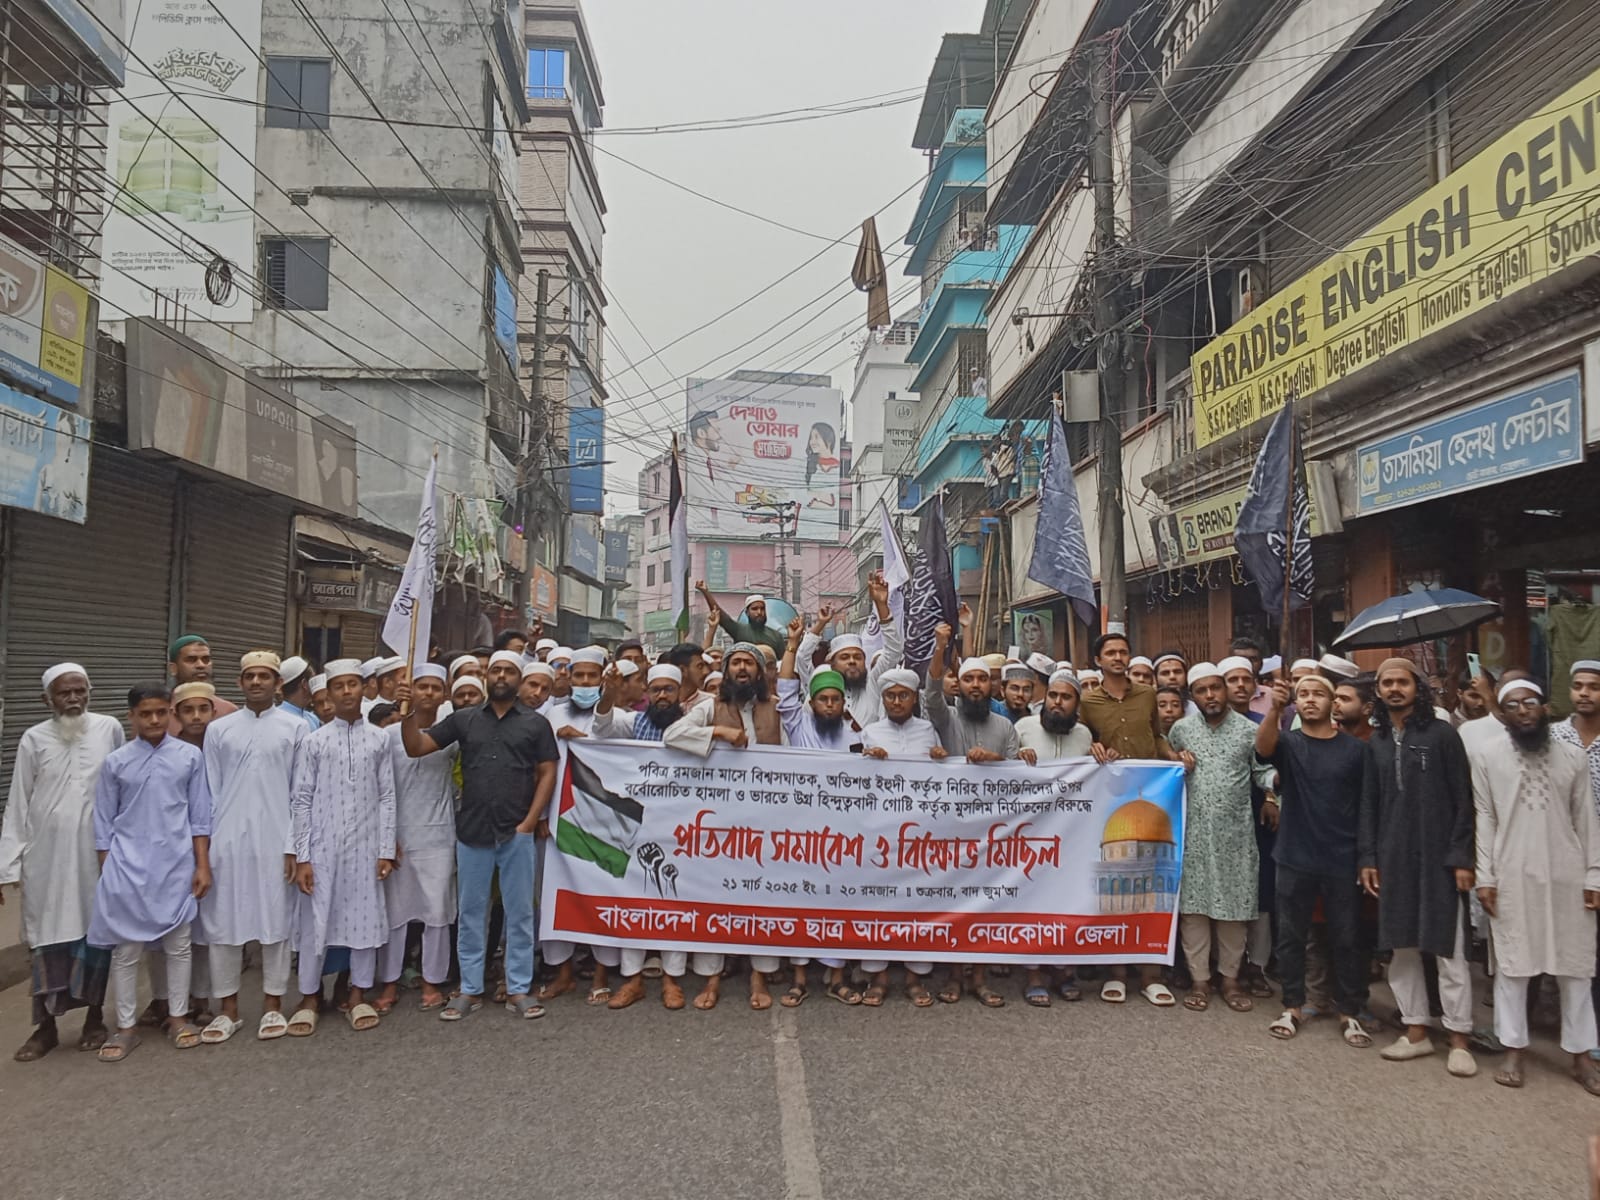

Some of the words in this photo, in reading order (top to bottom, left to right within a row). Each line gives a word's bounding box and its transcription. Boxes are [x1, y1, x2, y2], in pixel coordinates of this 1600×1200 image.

[1200, 294, 1307, 402] PARADISE
[1321, 184, 1470, 330] ENGLISH
[1495, 97, 1600, 221] CEN
[1478, 243, 1529, 300] English
[1325, 337, 1362, 378] Degree
[1364, 307, 1407, 358] English
[1259, 374, 1281, 414] H.S.C
[1283, 356, 1316, 401] English
[729, 405, 777, 421] দেখাও
[746, 421, 799, 438] তোমার
[1208, 406, 1225, 438] S.S.C
[1227, 392, 1253, 431] English
[1381, 435, 1443, 484] তাসমিয়া
[1503, 397, 1571, 450] সেন্টার
[1196, 506, 1232, 535] BRAND
[625, 780, 691, 798] বর্বোরোচিত
[695, 784, 731, 801] হামলা
[735, 790, 745, 801] ও
[749, 788, 789, 805] ভারতে
[793, 788, 813, 808] উগ্র
[918, 798, 951, 820] কর্তৃক
[955, 797, 993, 817] মুসলিম
[998, 796, 1052, 816] নির্যাতনের
[1054, 797, 1093, 814] বিরুদ্ধে
[638, 761, 668, 779] পবিত্র
[673, 766, 714, 780] রমজান
[718, 767, 746, 782] মাসে
[827, 771, 872, 791] অভিশপ্ত
[875, 774, 905, 794] ইহুদী
[910, 777, 943, 799] কর্তৃক
[946, 777, 979, 796] নিরিহ
[1056, 778, 1084, 794] উপর
[673, 810, 764, 868] প্রতিবাদ
[771, 825, 864, 874] সমাবেশ
[870, 835, 889, 869] ও
[897, 822, 981, 876] বিক্ষোভ
[986, 822, 1061, 881] মিছিল
[722, 878, 737, 890] ২১
[741, 876, 763, 891] মার্চ
[765, 880, 798, 894] ২০২৫
[802, 880, 817, 895] ইং
[840, 885, 856, 897] ২০
[861, 885, 898, 898] রমজান
[916, 885, 957, 899] শুক্রবার,
[961, 885, 979, 898] বাদ
[596, 904, 699, 933] বাংলাদেশ
[706, 911, 798, 937] খেলাফত
[804, 916, 846, 942] ছাত্র
[851, 919, 957, 947] আন্দোলন,
[968, 919, 1068, 946] নেত্রকোণা
[1075, 922, 1129, 946] জেলা
